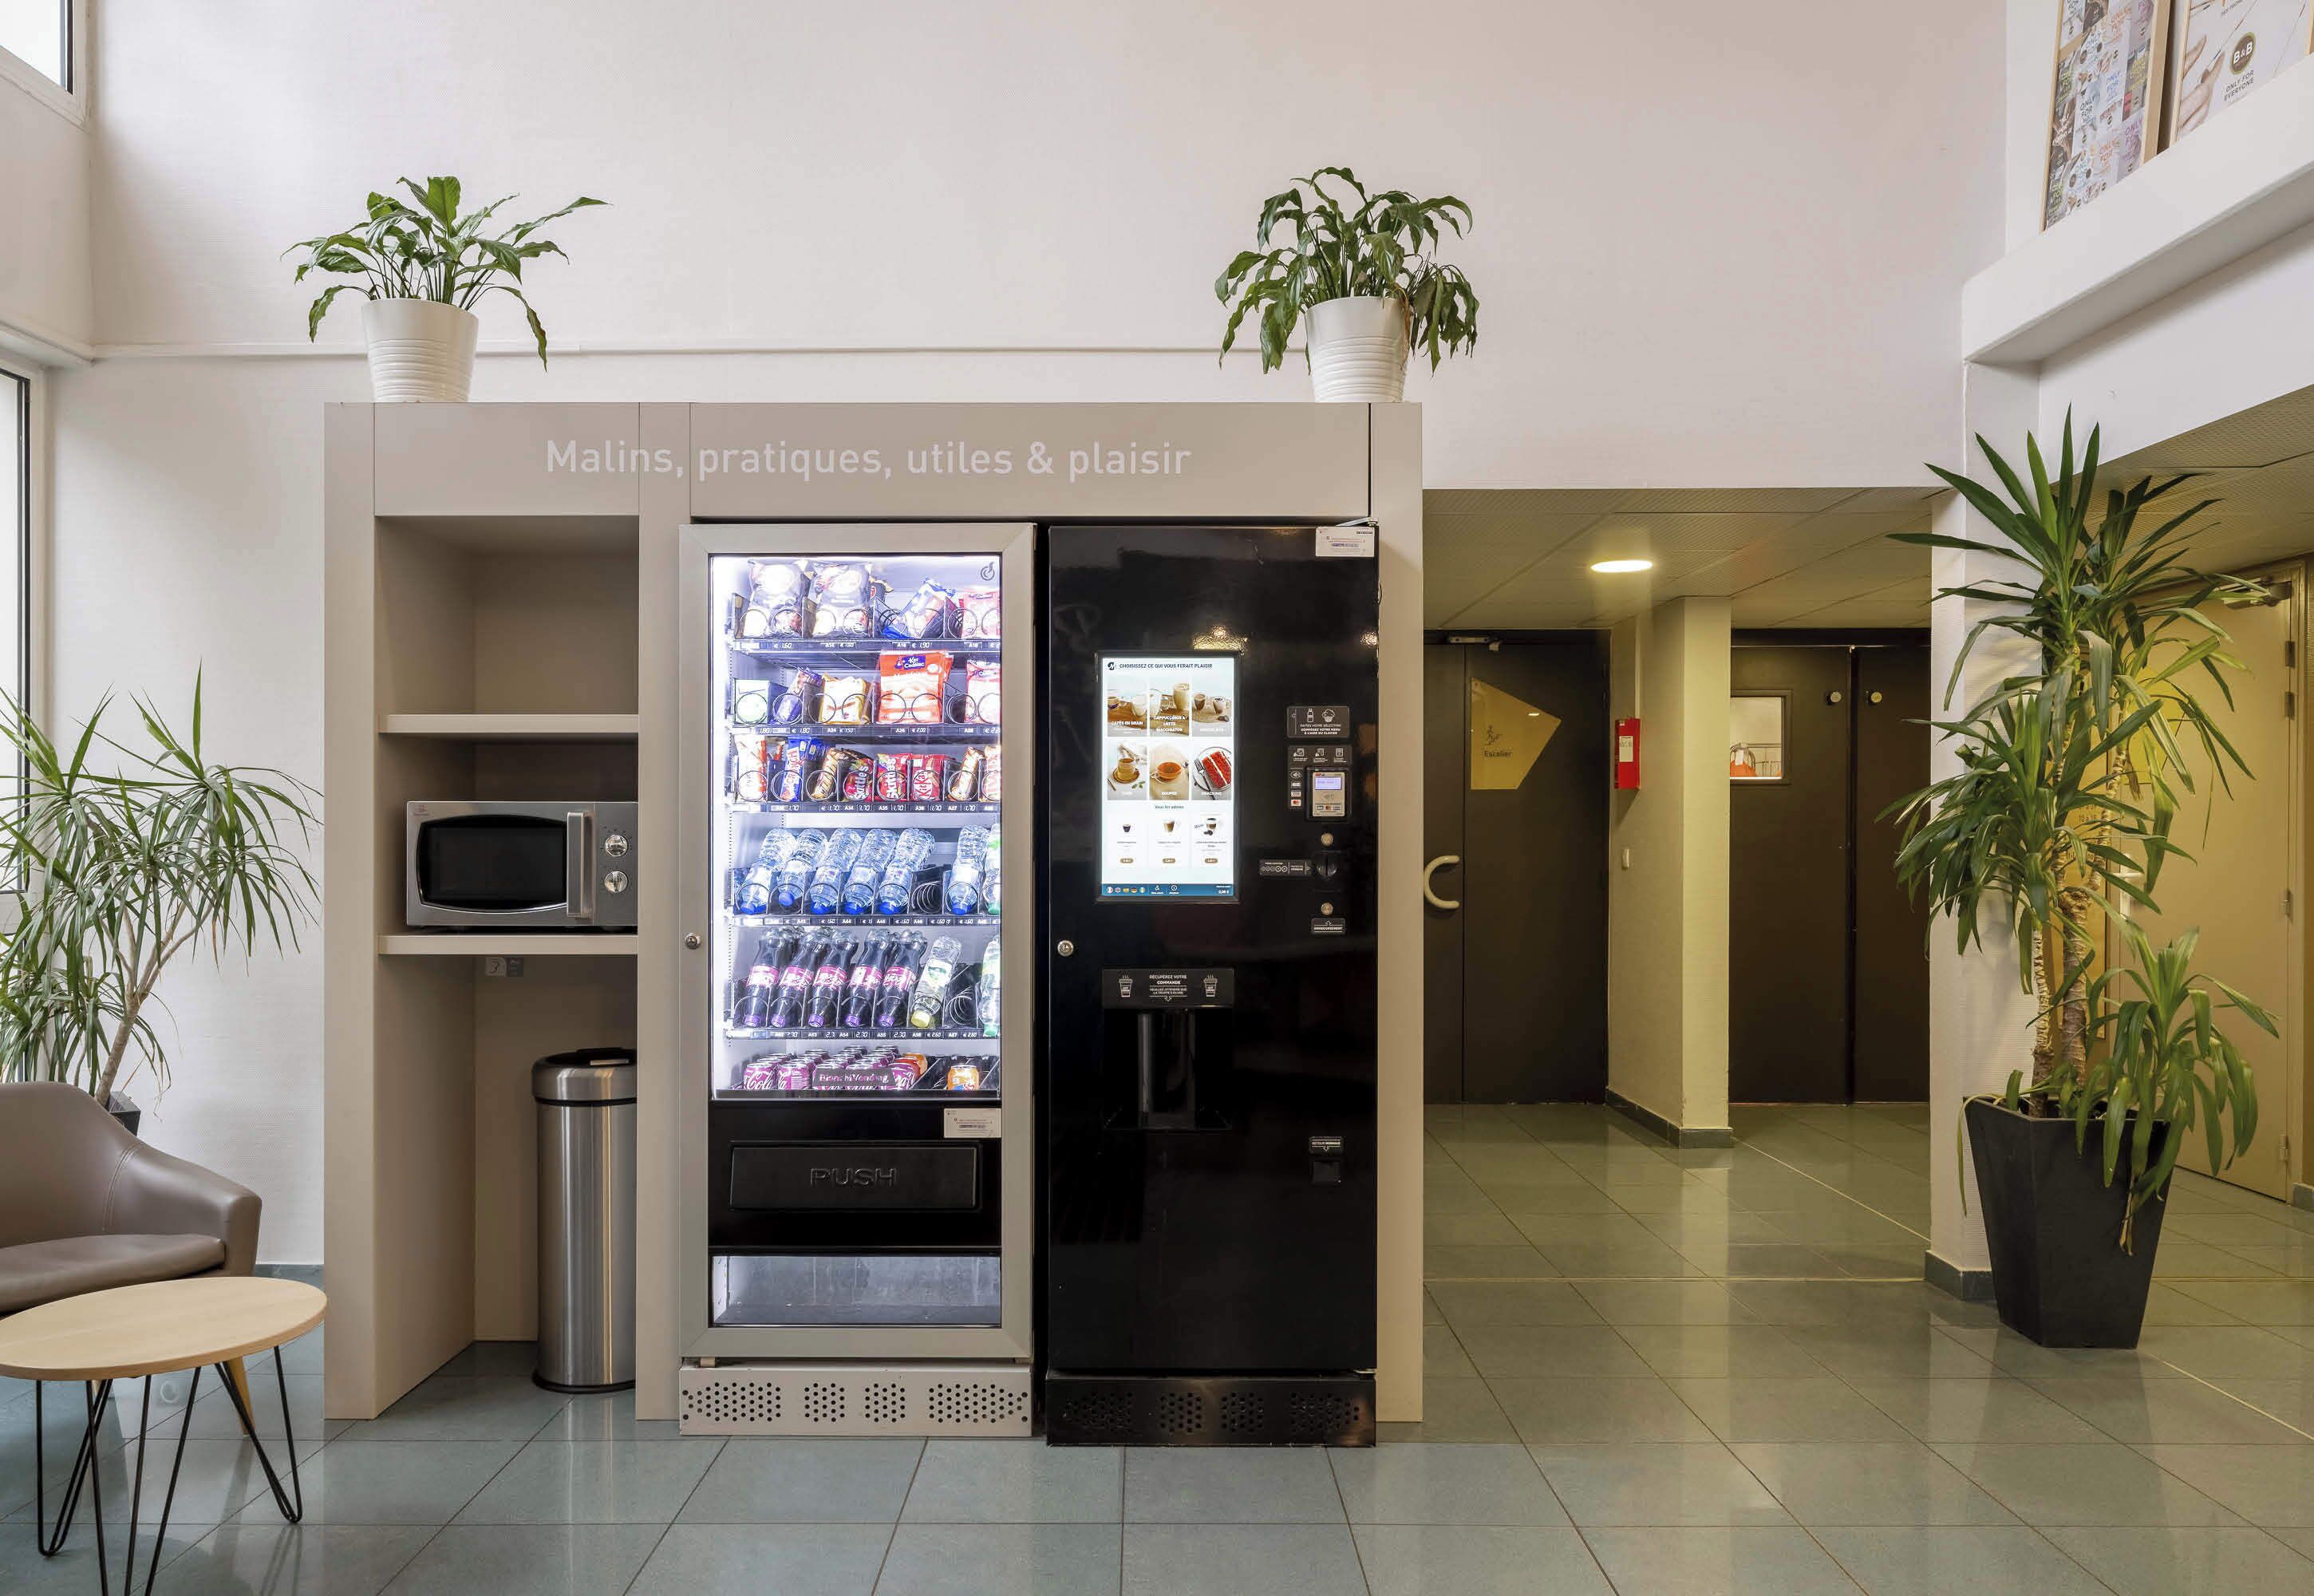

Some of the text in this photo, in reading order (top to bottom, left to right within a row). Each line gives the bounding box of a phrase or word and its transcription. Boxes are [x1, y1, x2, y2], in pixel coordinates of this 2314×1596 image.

[2233, 41, 2253, 64] B&B
[2226, 69, 2254, 93] ONLY FOR
[545, 440, 1192, 482] Malins, pratiques, utiles & plaisir
[810, 1167, 897, 1187] PUSH
